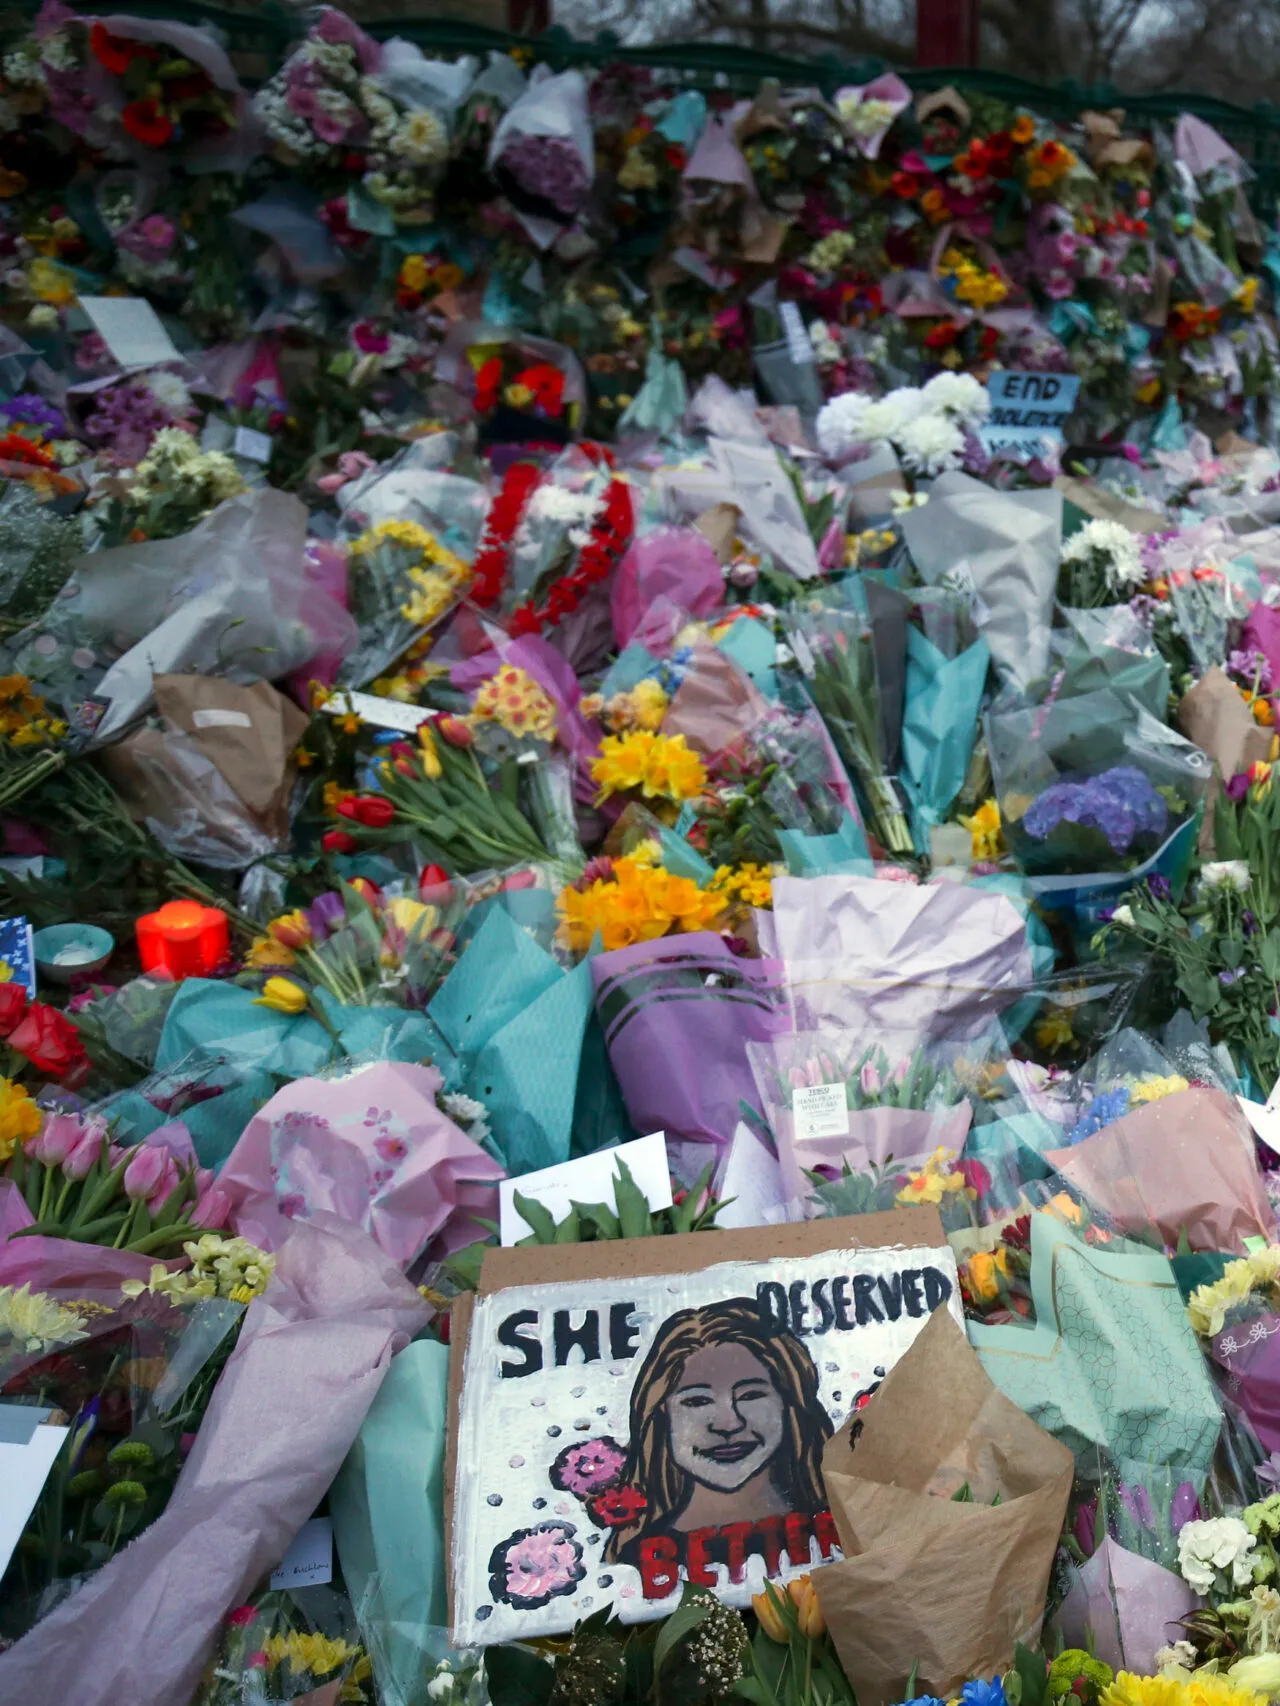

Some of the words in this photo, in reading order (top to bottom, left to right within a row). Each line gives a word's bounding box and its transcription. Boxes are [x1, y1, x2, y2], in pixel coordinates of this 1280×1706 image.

[1003, 375, 1061, 401] END
[498, 1301, 640, 1379] SHE
[756, 1266, 953, 1336] DESERVED
